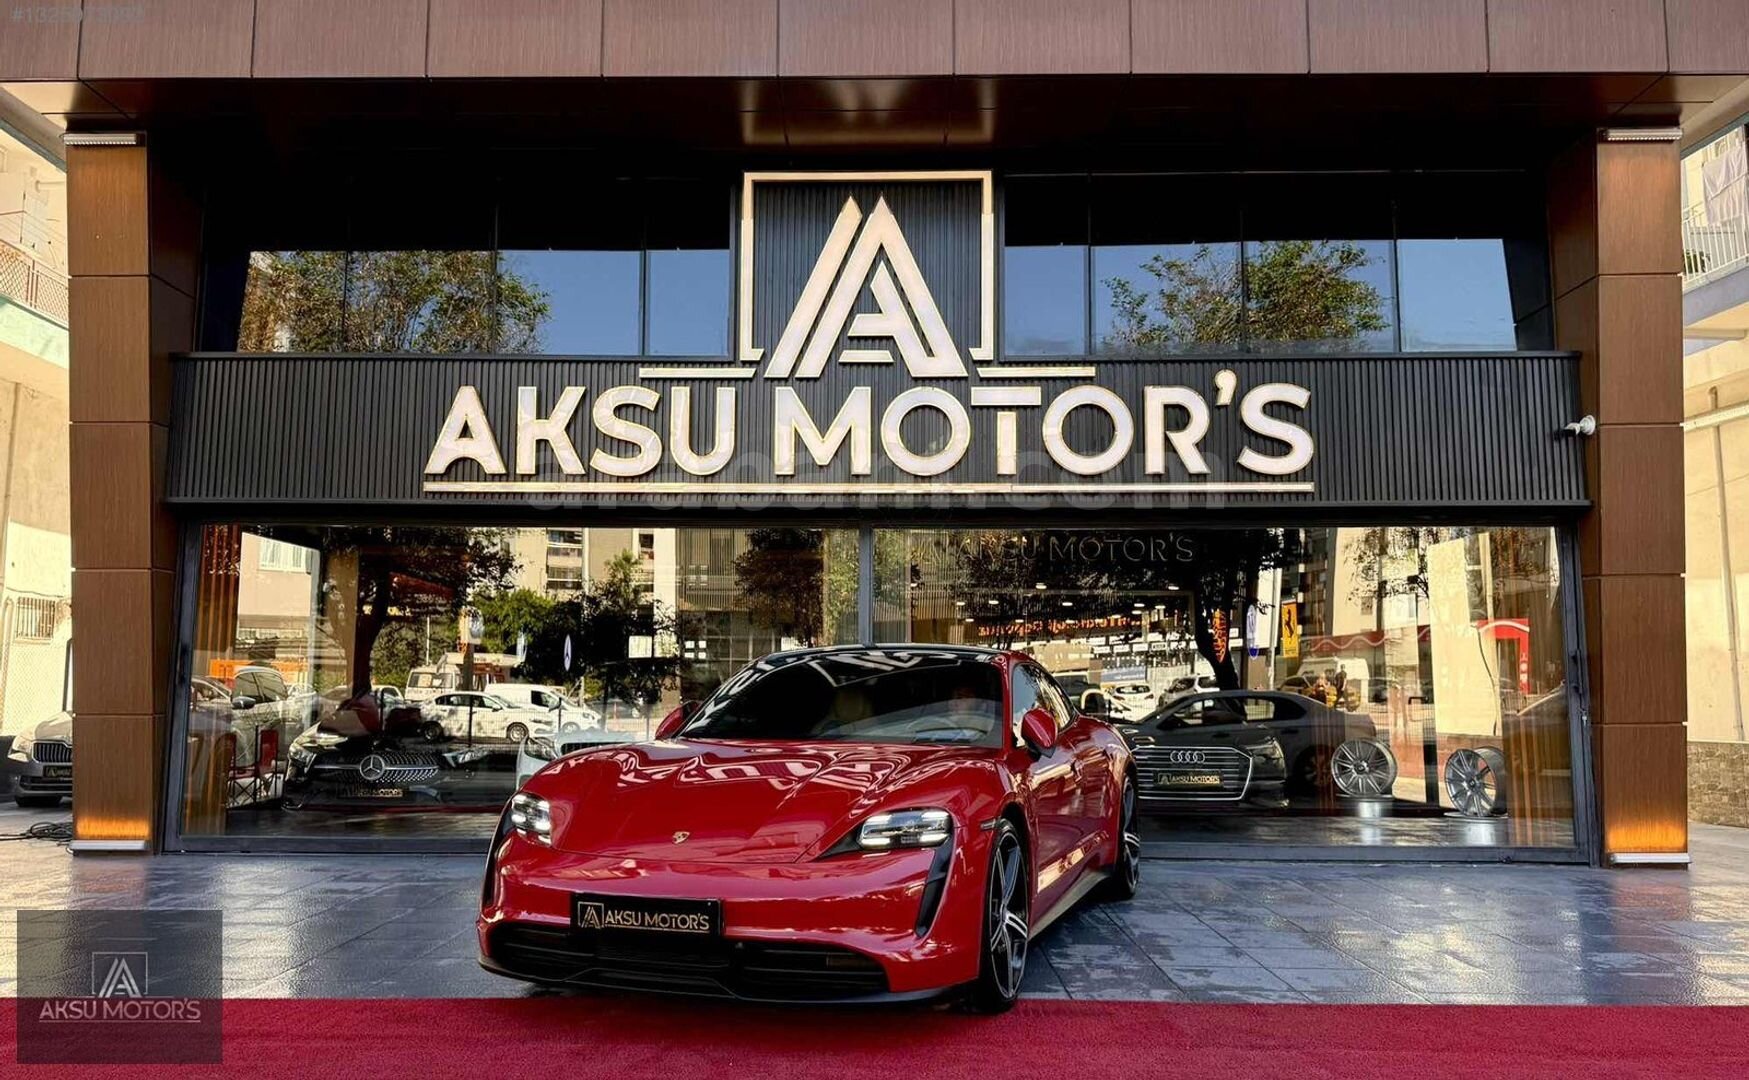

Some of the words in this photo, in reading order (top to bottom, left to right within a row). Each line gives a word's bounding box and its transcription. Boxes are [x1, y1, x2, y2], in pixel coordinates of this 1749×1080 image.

[424, 385, 736, 476] AKSU
[775, 369, 1315, 477] MOTOR'S
[1050, 532, 1194, 562] MOTOR'S
[604, 910, 642, 926] AKSU
[644, 912, 710, 930] MOTOR'S
